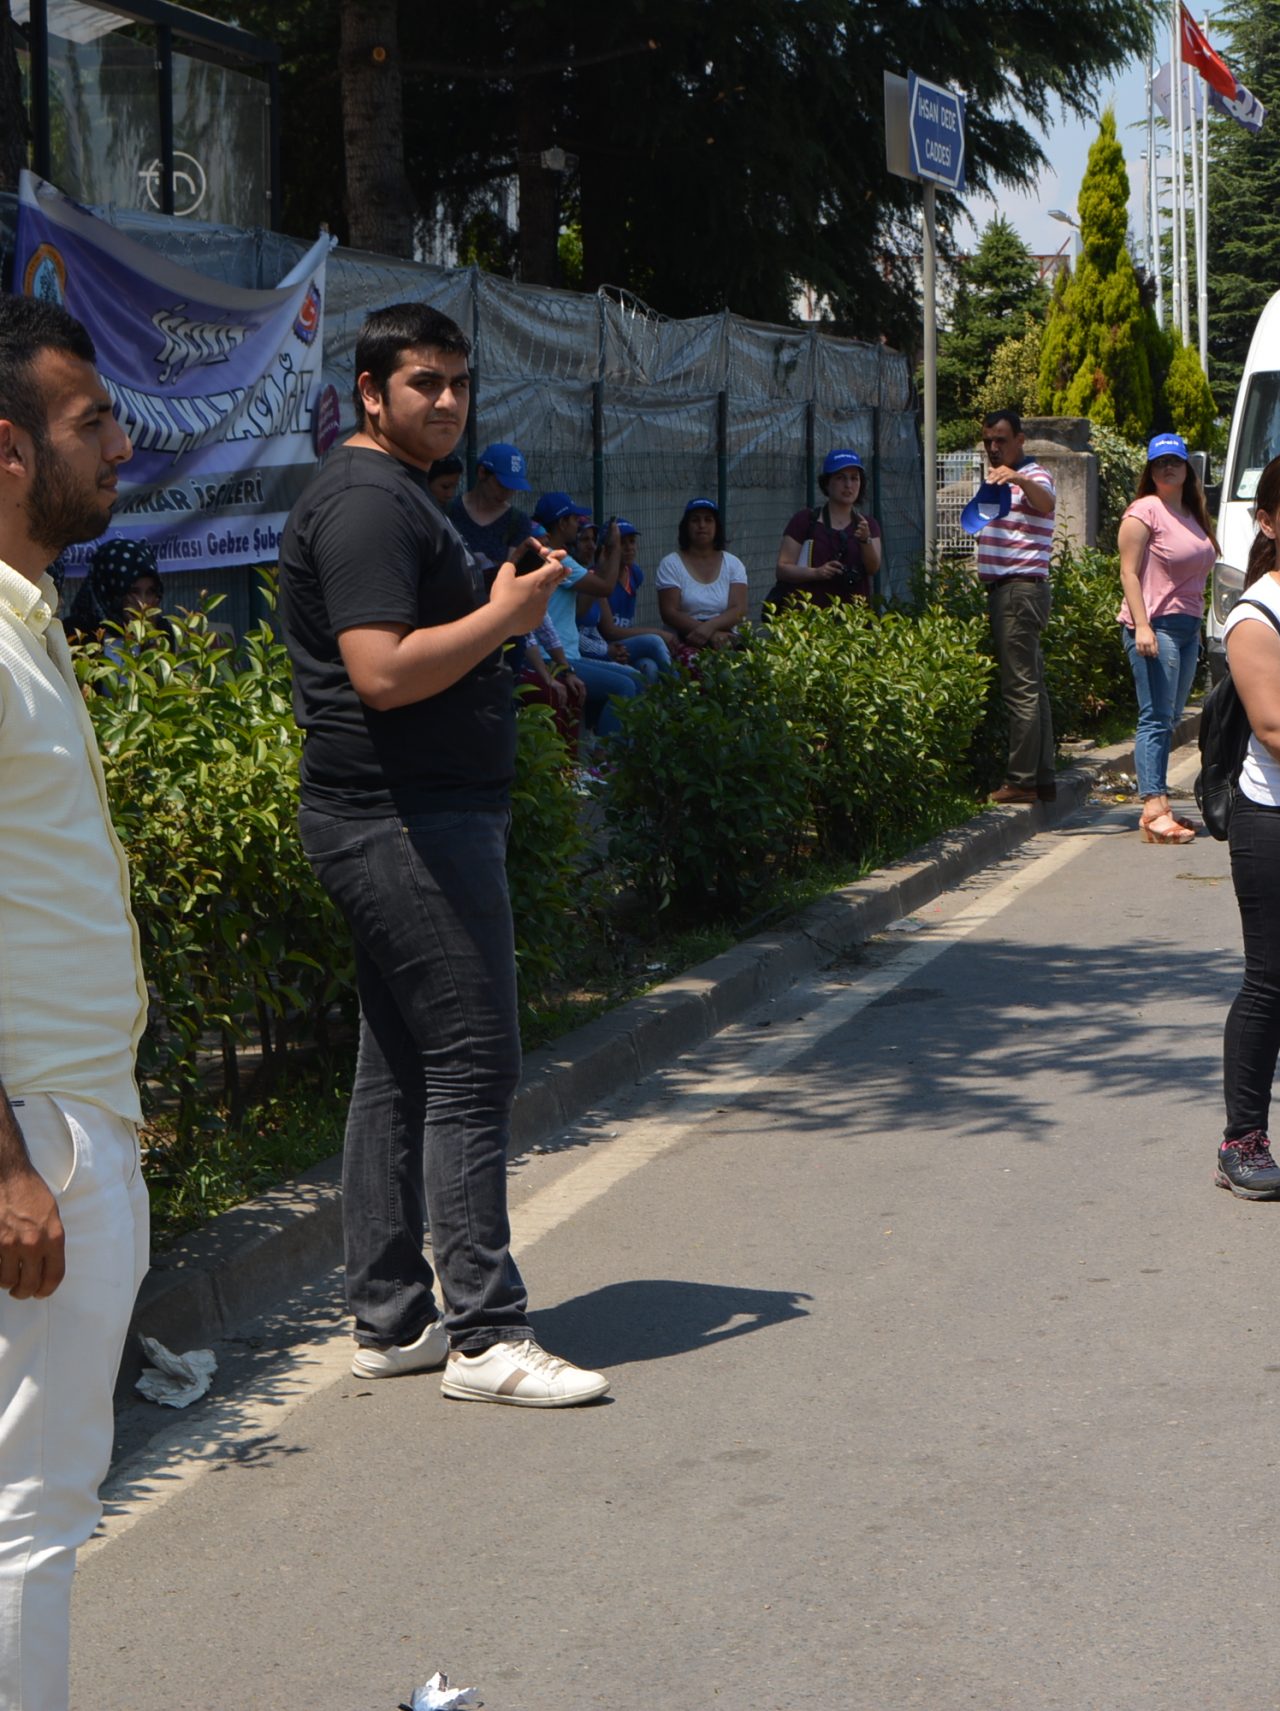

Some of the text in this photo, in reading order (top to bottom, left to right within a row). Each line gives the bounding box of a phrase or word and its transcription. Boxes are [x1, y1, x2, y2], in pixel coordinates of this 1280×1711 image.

[918, 92, 957, 133] İHSAN DEDE
[925, 138, 952, 168] CADDESİ
[206, 530, 250, 557] Gebze
